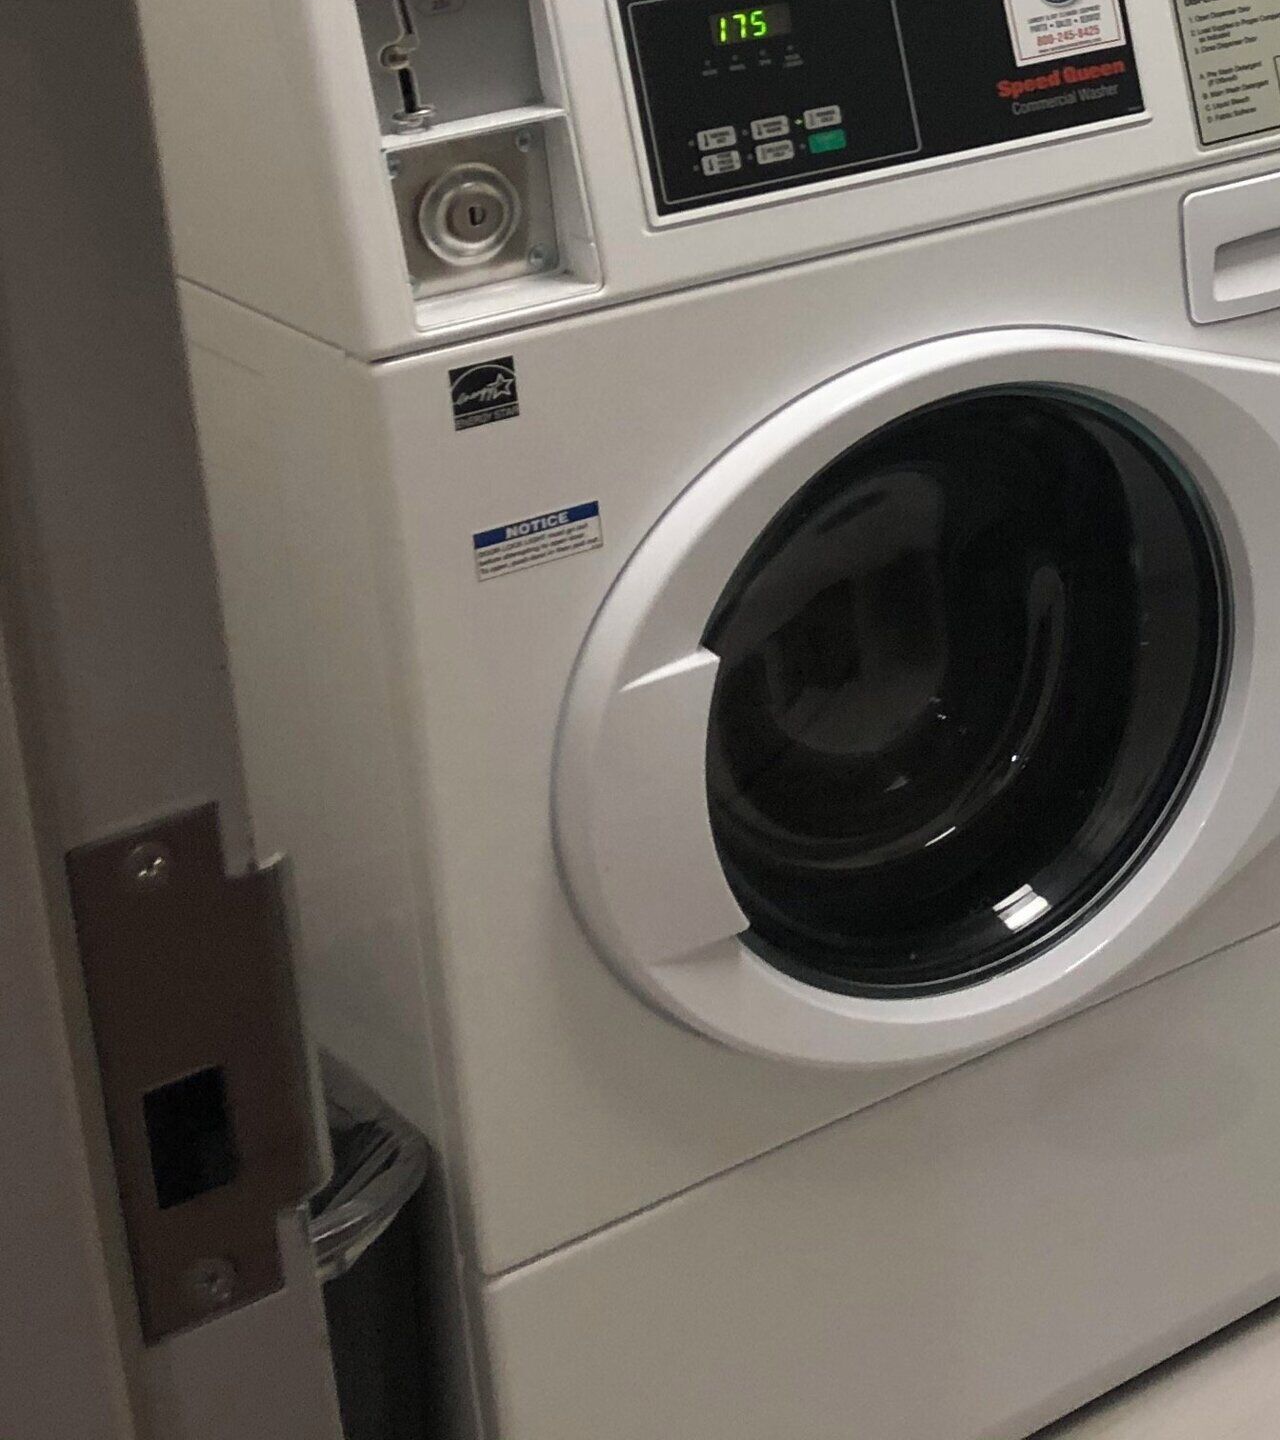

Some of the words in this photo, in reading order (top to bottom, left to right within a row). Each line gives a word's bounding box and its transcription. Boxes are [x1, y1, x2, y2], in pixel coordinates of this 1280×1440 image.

[720, 10, 767, 42] 175
[997, 70, 1060, 98] Speed
[1063, 61, 1125, 83] Queen
[1012, 91, 1077, 115] Commercial
[1079, 83, 1119, 101] Washer
[505, 511, 570, 539] NOTICE
